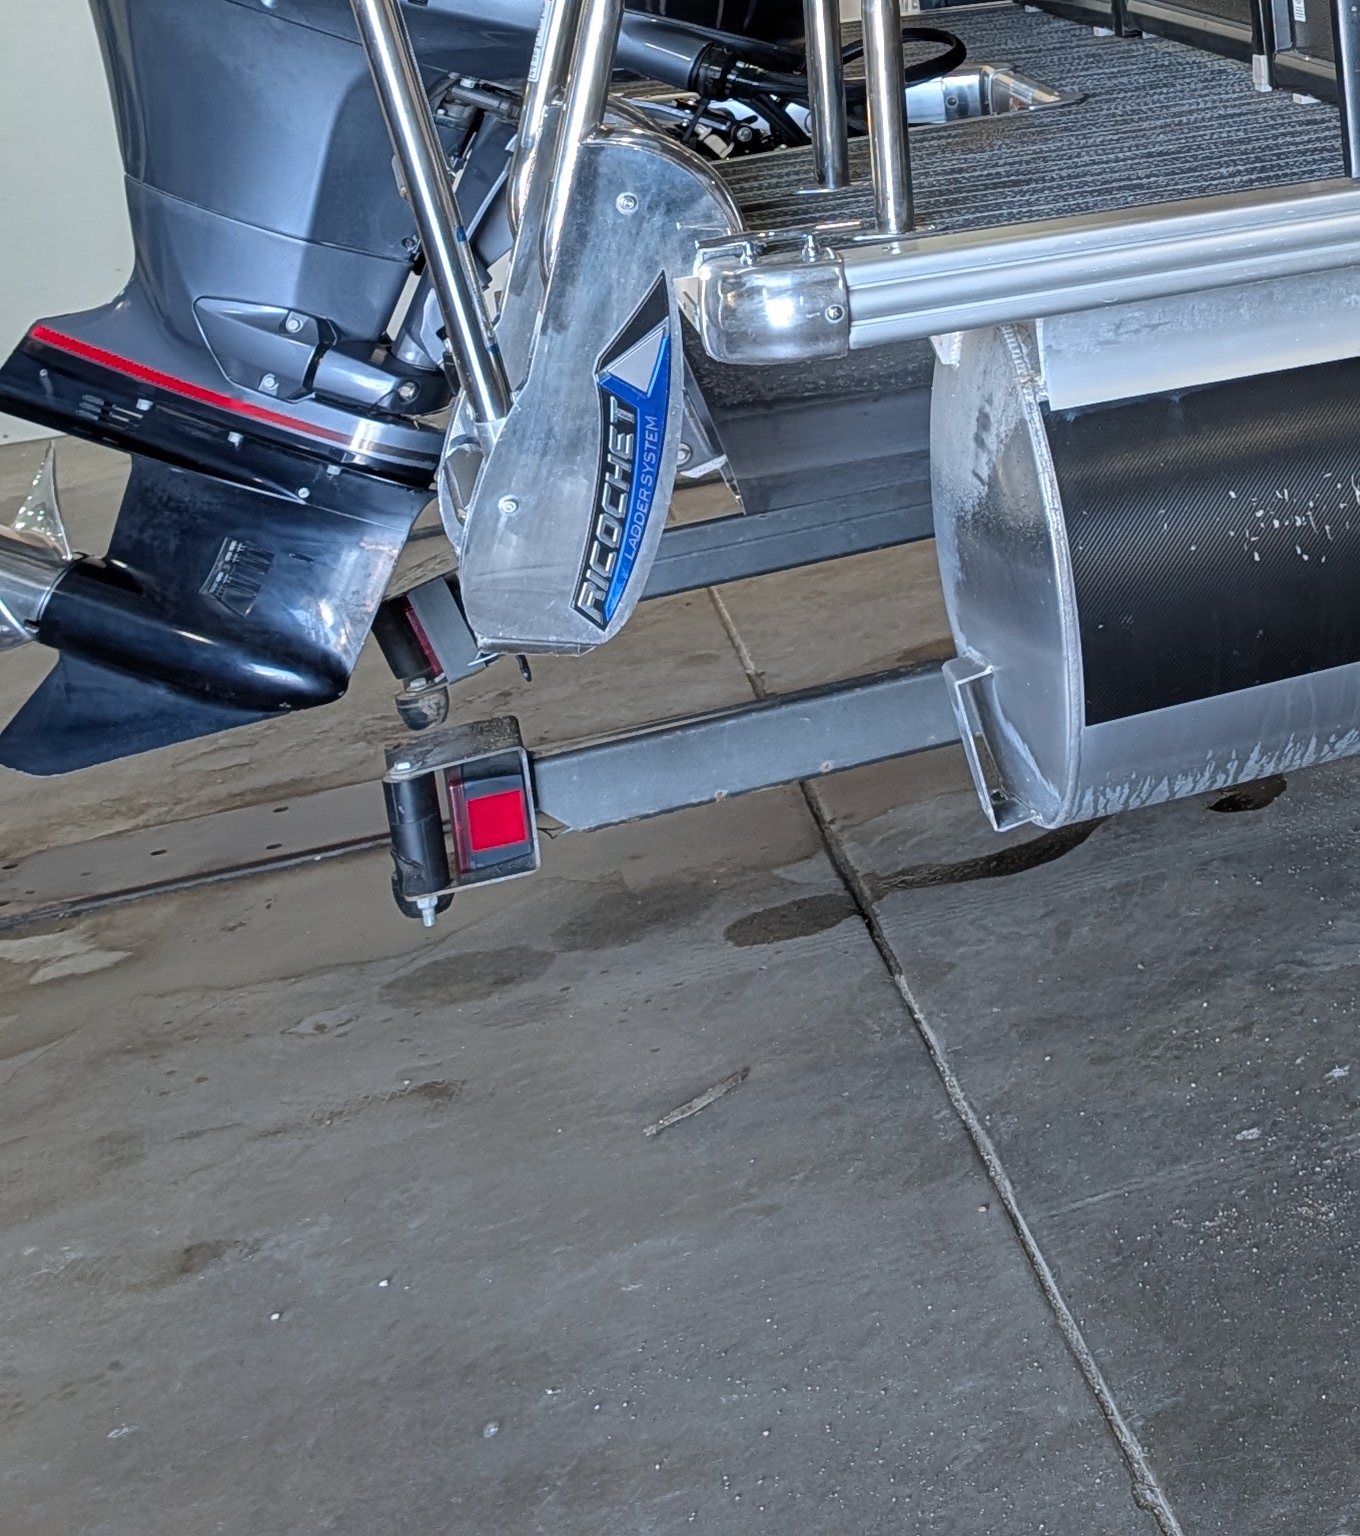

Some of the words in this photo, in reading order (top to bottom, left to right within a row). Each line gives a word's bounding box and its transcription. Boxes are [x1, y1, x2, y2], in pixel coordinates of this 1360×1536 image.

[577, 395, 636, 624] RICOCHET
[627, 486, 652, 562] LADDER
[640, 415, 660, 487] SYSTEM
